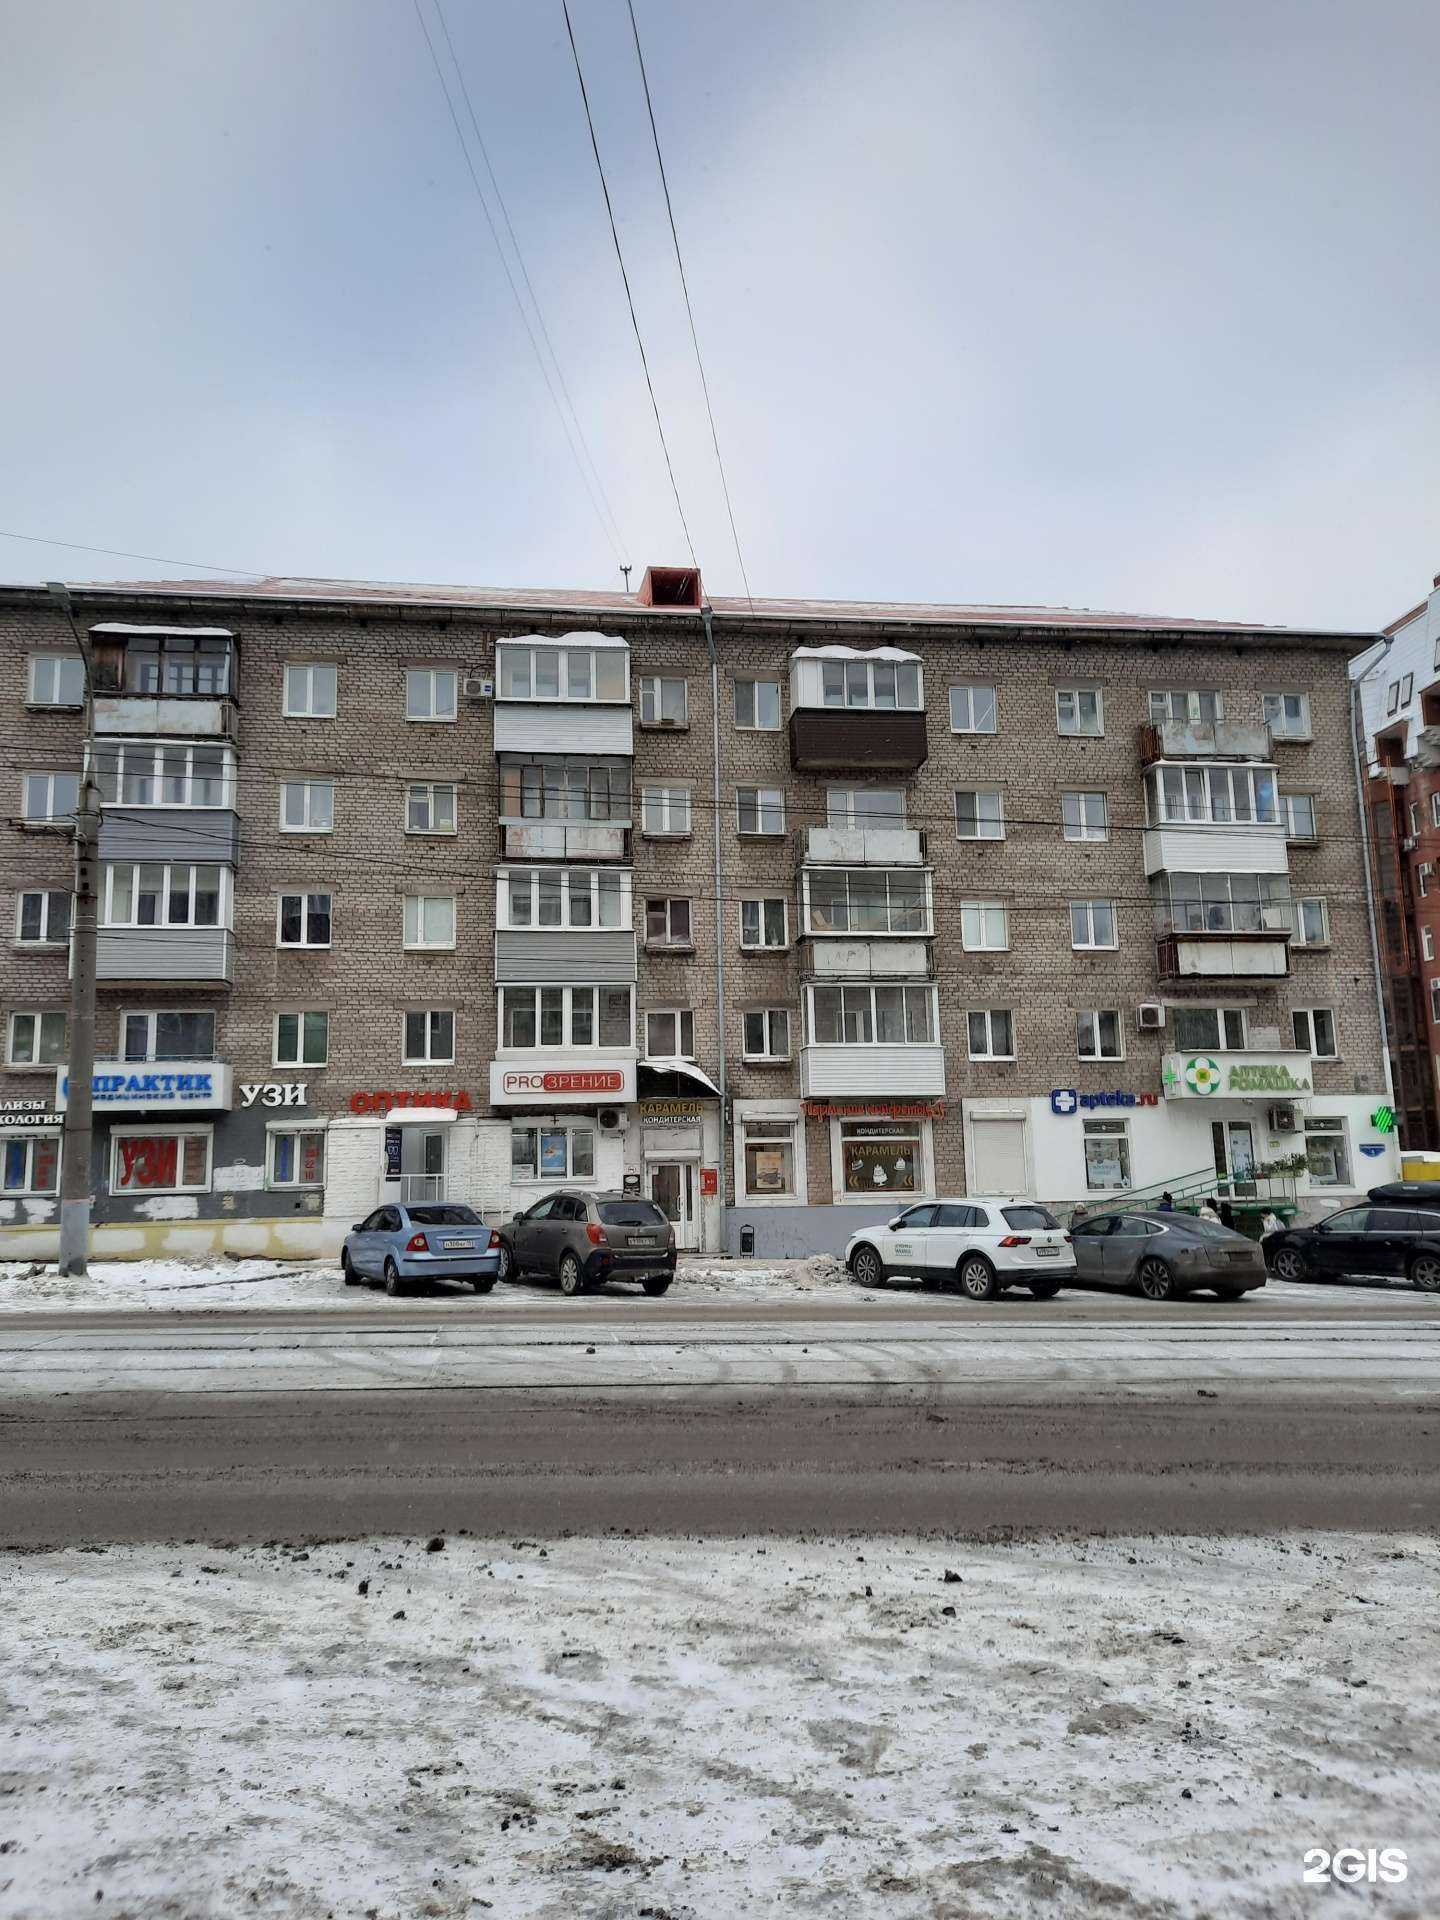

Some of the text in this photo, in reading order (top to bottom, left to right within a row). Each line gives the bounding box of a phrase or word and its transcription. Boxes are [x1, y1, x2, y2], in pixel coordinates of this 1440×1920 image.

[1229, 1065, 1290, 1079] АПТЕКА
[92, 1074, 212, 1092] ПРАКТИК
[506, 1074, 618, 1089] PROЗРЕНИЕ
[1229, 1077, 1311, 1092] РОМАШКА
[239, 1083, 308, 1107] УЗИ
[351, 1089, 472, 1114] ОПТИКА
[1080, 1090, 1159, 1110] apteka.ru
[0, 1100, 46, 1111] ЛИЗЫ
[640, 1102, 704, 1115] КАРАМЕЛЬ
[643, 1115, 701, 1124] КОНДИТЕРСКАЯ
[856, 1127, 905, 1135] КОНДИТЕРСКАЯ
[851, 1143, 911, 1157] КАРАМЕЛЬ
